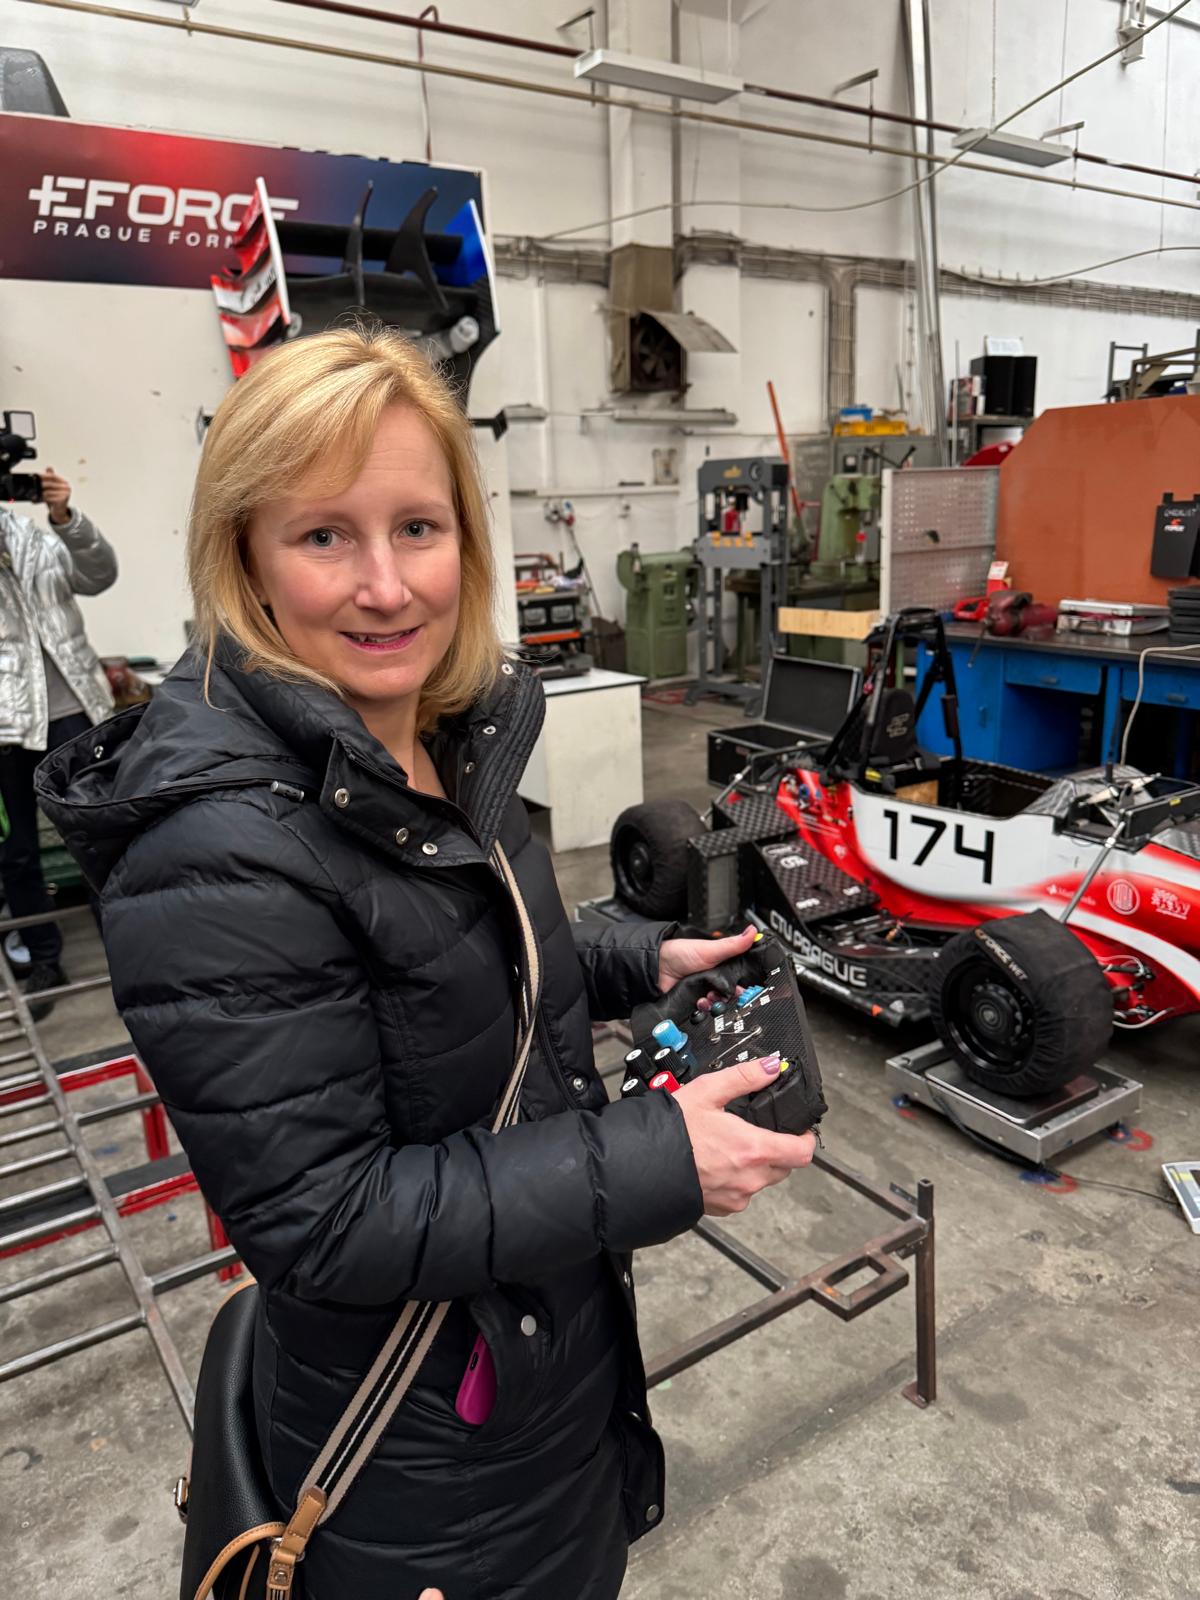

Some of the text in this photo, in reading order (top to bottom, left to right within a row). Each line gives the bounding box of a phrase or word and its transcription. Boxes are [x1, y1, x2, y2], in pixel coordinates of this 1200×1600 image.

[33, 219, 151, 243] PRAGUE
[883, 809, 995, 885] 174
[769, 909, 793, 942] CTU
[792, 929, 868, 988] PRAGUE
